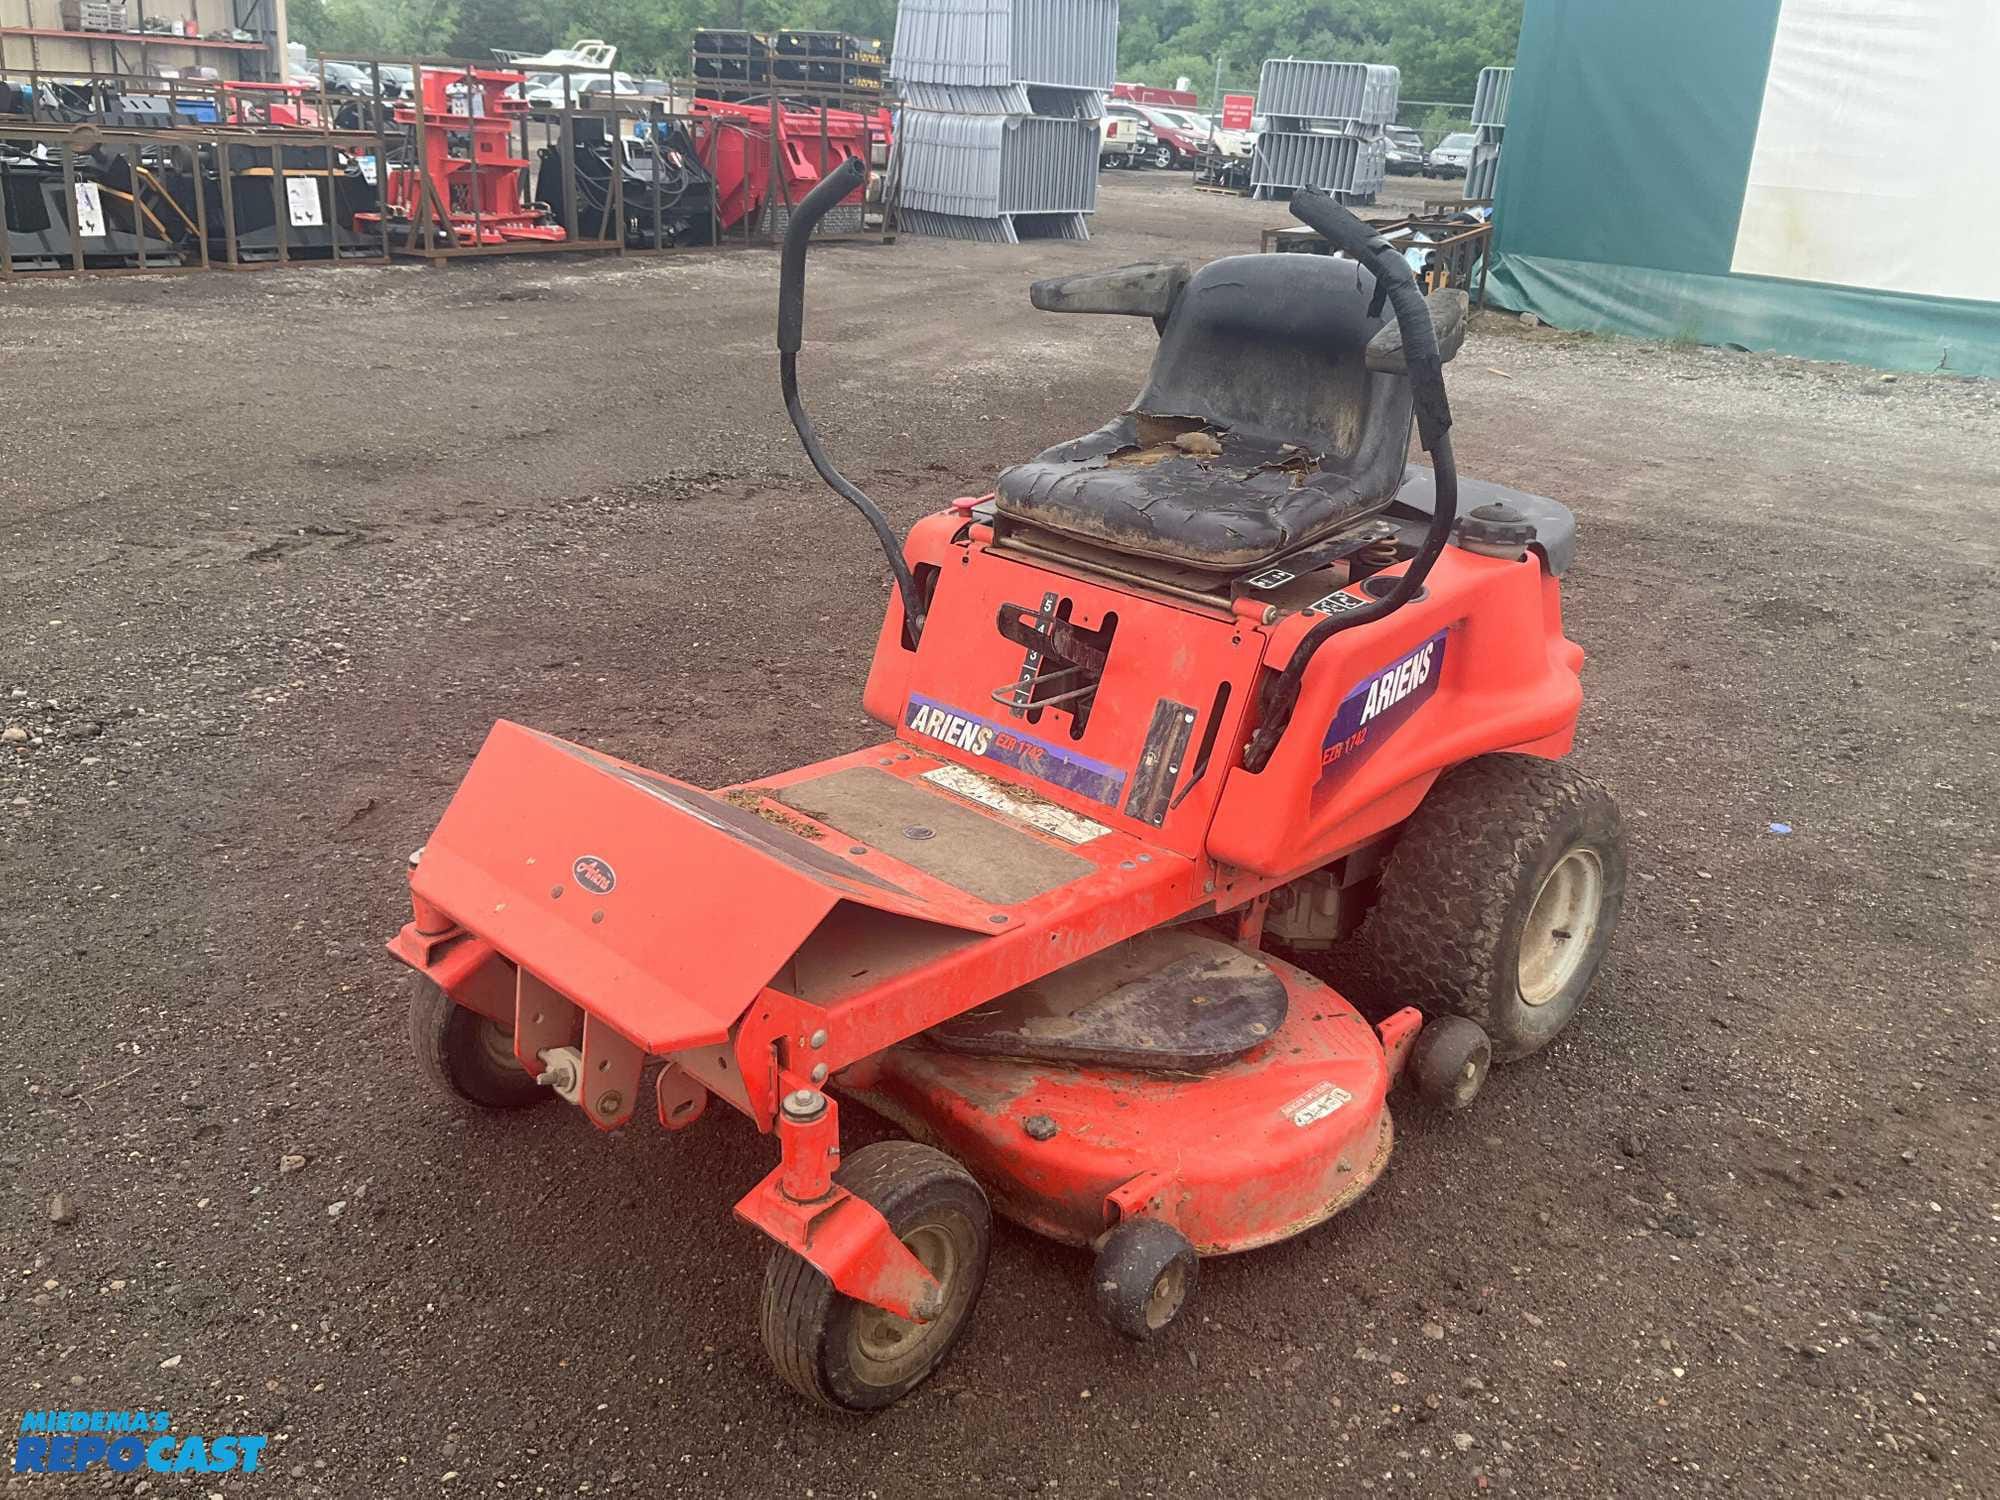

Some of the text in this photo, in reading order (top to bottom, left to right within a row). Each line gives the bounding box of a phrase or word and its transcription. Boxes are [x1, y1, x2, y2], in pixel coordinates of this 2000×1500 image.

[1043, 600, 1053, 612] 5
[1037, 623, 1045, 634] 4
[1029, 650, 1038, 661] 3
[1360, 641, 1434, 726] ARIENS
[910, 704, 993, 756] ARIENS
[995, 732, 1017, 750] EZR
